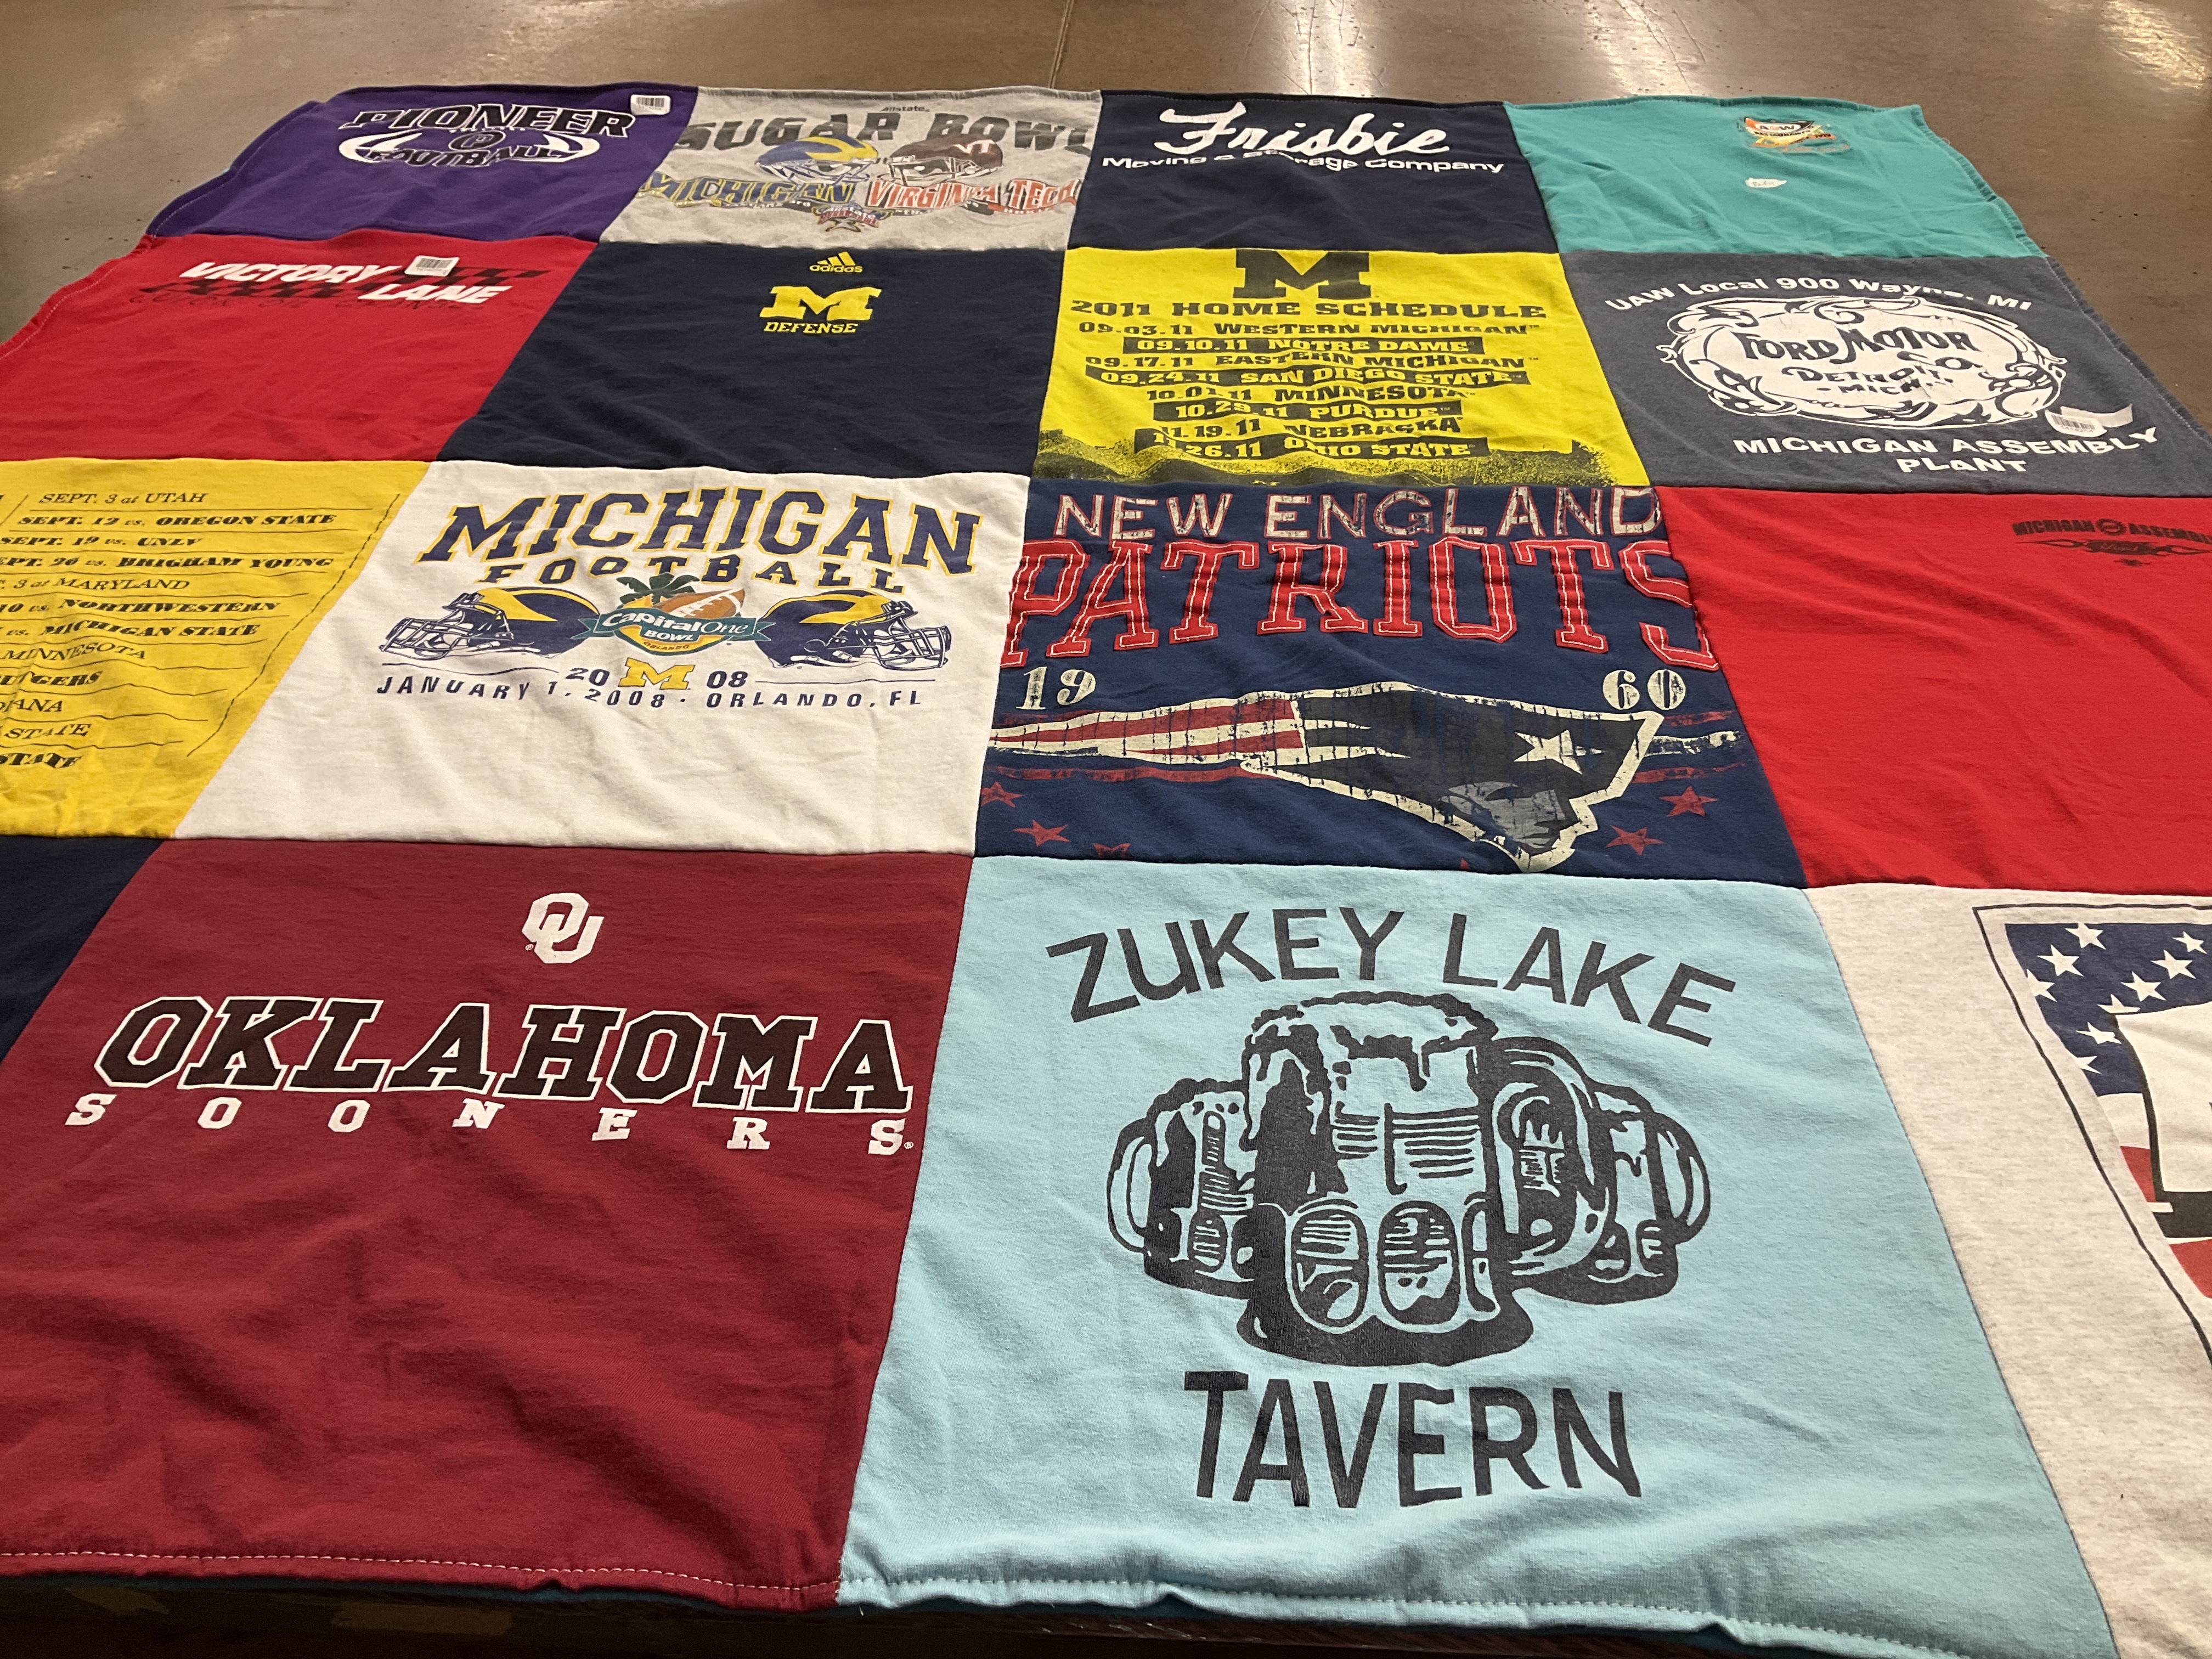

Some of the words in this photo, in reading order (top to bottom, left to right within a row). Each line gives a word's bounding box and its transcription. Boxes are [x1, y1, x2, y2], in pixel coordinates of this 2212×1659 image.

[338, 103, 635, 138] PIONEER
[1154, 101, 1450, 156] Frisbie
[674, 112, 901, 151] SUGAR
[1102, 157, 1207, 168] Moving
[1365, 158, 1504, 173] Company
[179, 262, 403, 283] VICTORY
[809, 264, 864, 273] adidas
[357, 283, 514, 303] LANE
[1605, 286, 1675, 311] UAW
[1677, 278, 1769, 296] Local
[1775, 276, 1840, 290] 900
[1987, 294, 2032, 311] MI
[759, 286, 882, 321] M
[1070, 300, 1151, 317] 2011
[1171, 302, 1301, 317] HOME
[1315, 302, 1547, 319] SCHEDULE
[763, 321, 859, 334] DEFENSE
[1079, 321, 1193, 335] 09.03.11
[1214, 323, 1361, 335] WESTERN
[1137, 339, 1248, 351] 09.10.11
[1268, 339, 1370, 352] NOTRE
[1378, 340, 1469, 352] DAME
[1730, 331, 1839, 360] FORD
[1829, 326, 1983, 364] MOTOR
[1085, 356, 1194, 368] 09.17.11
[1215, 352, 1354, 366] EASTERN
[1100, 371, 1220, 385] 09.24.11
[1240, 369, 1304, 383] SAN
[1313, 367, 1406, 382] DIEGO
[1414, 370, 1513, 386] STATE
[1274, 385, 1469, 402] MINNESOTA
[1175, 401, 1288, 419] 10.29.11
[1309, 403, 1438, 419] PURDUE
[1283, 417, 1462, 438] NEBRASKA
[1372, 442, 1471, 457] STATE
[1733, 437, 1939, 454] MICHIGAN
[1953, 426, 2158, 454] ASSEMBLY
[1896, 457, 2027, 473] PLANT
[38, 493, 97, 504] SEPT.
[104, 494, 118, 504] 3
[121, 495, 139, 504] at
[144, 493, 208, 504] UTAH
[17, 516, 83, 524] SEPT.
[93, 517, 120, 525] 12
[156, 516, 258, 525] OREGON
[261, 514, 337, 525] STATE
[1053, 492, 1234, 542] NEW
[1263, 486, 1663, 540] ENGLAND
[412, 485, 984, 577] MICHIGAN
[0, 537, 63, 545] SEPT.
[72, 536, 100, 545] 19
[137, 537, 204, 546] UNLV
[116, 557, 244, 567] BRIGHAM
[250, 557, 335, 568] YOUNG
[474, 553, 905, 595] FOOTBALL
[13, 579, 28, 589] 3
[53, 578, 190, 590] MARYLAND
[58, 598, 281, 613] NORTHWESTERN
[1000, 535, 1720, 671] PATRIOTS
[38, 619, 174, 636] MICHIGAN
[178, 624, 260, 637] STATE
[643, 629, 695, 641] BOWL
[1, 641, 146, 661] MINNESOTA
[643, 641, 690, 650] ORLANDO
[0, 670, 104, 686] UTGERS
[565, 667, 610, 686] 20
[706, 670, 749, 689] 08
[376, 675, 531, 701] JANUARY
[584, 687, 665, 708] 2008
[889, 690, 922, 706] FL
[1015, 665, 1097, 711] 19
[1602, 669, 1687, 711] 60
[4, 723, 92, 740] STATE
[1046, 907, 1406, 1024] ZUKEY
[1442, 912, 1737, 1048] LAKE
[94, 996, 915, 1114] OKLAHOMA
[65, 1093, 906, 1156] SOONERS
[1184, 1370, 1642, 1509] TAVERN
